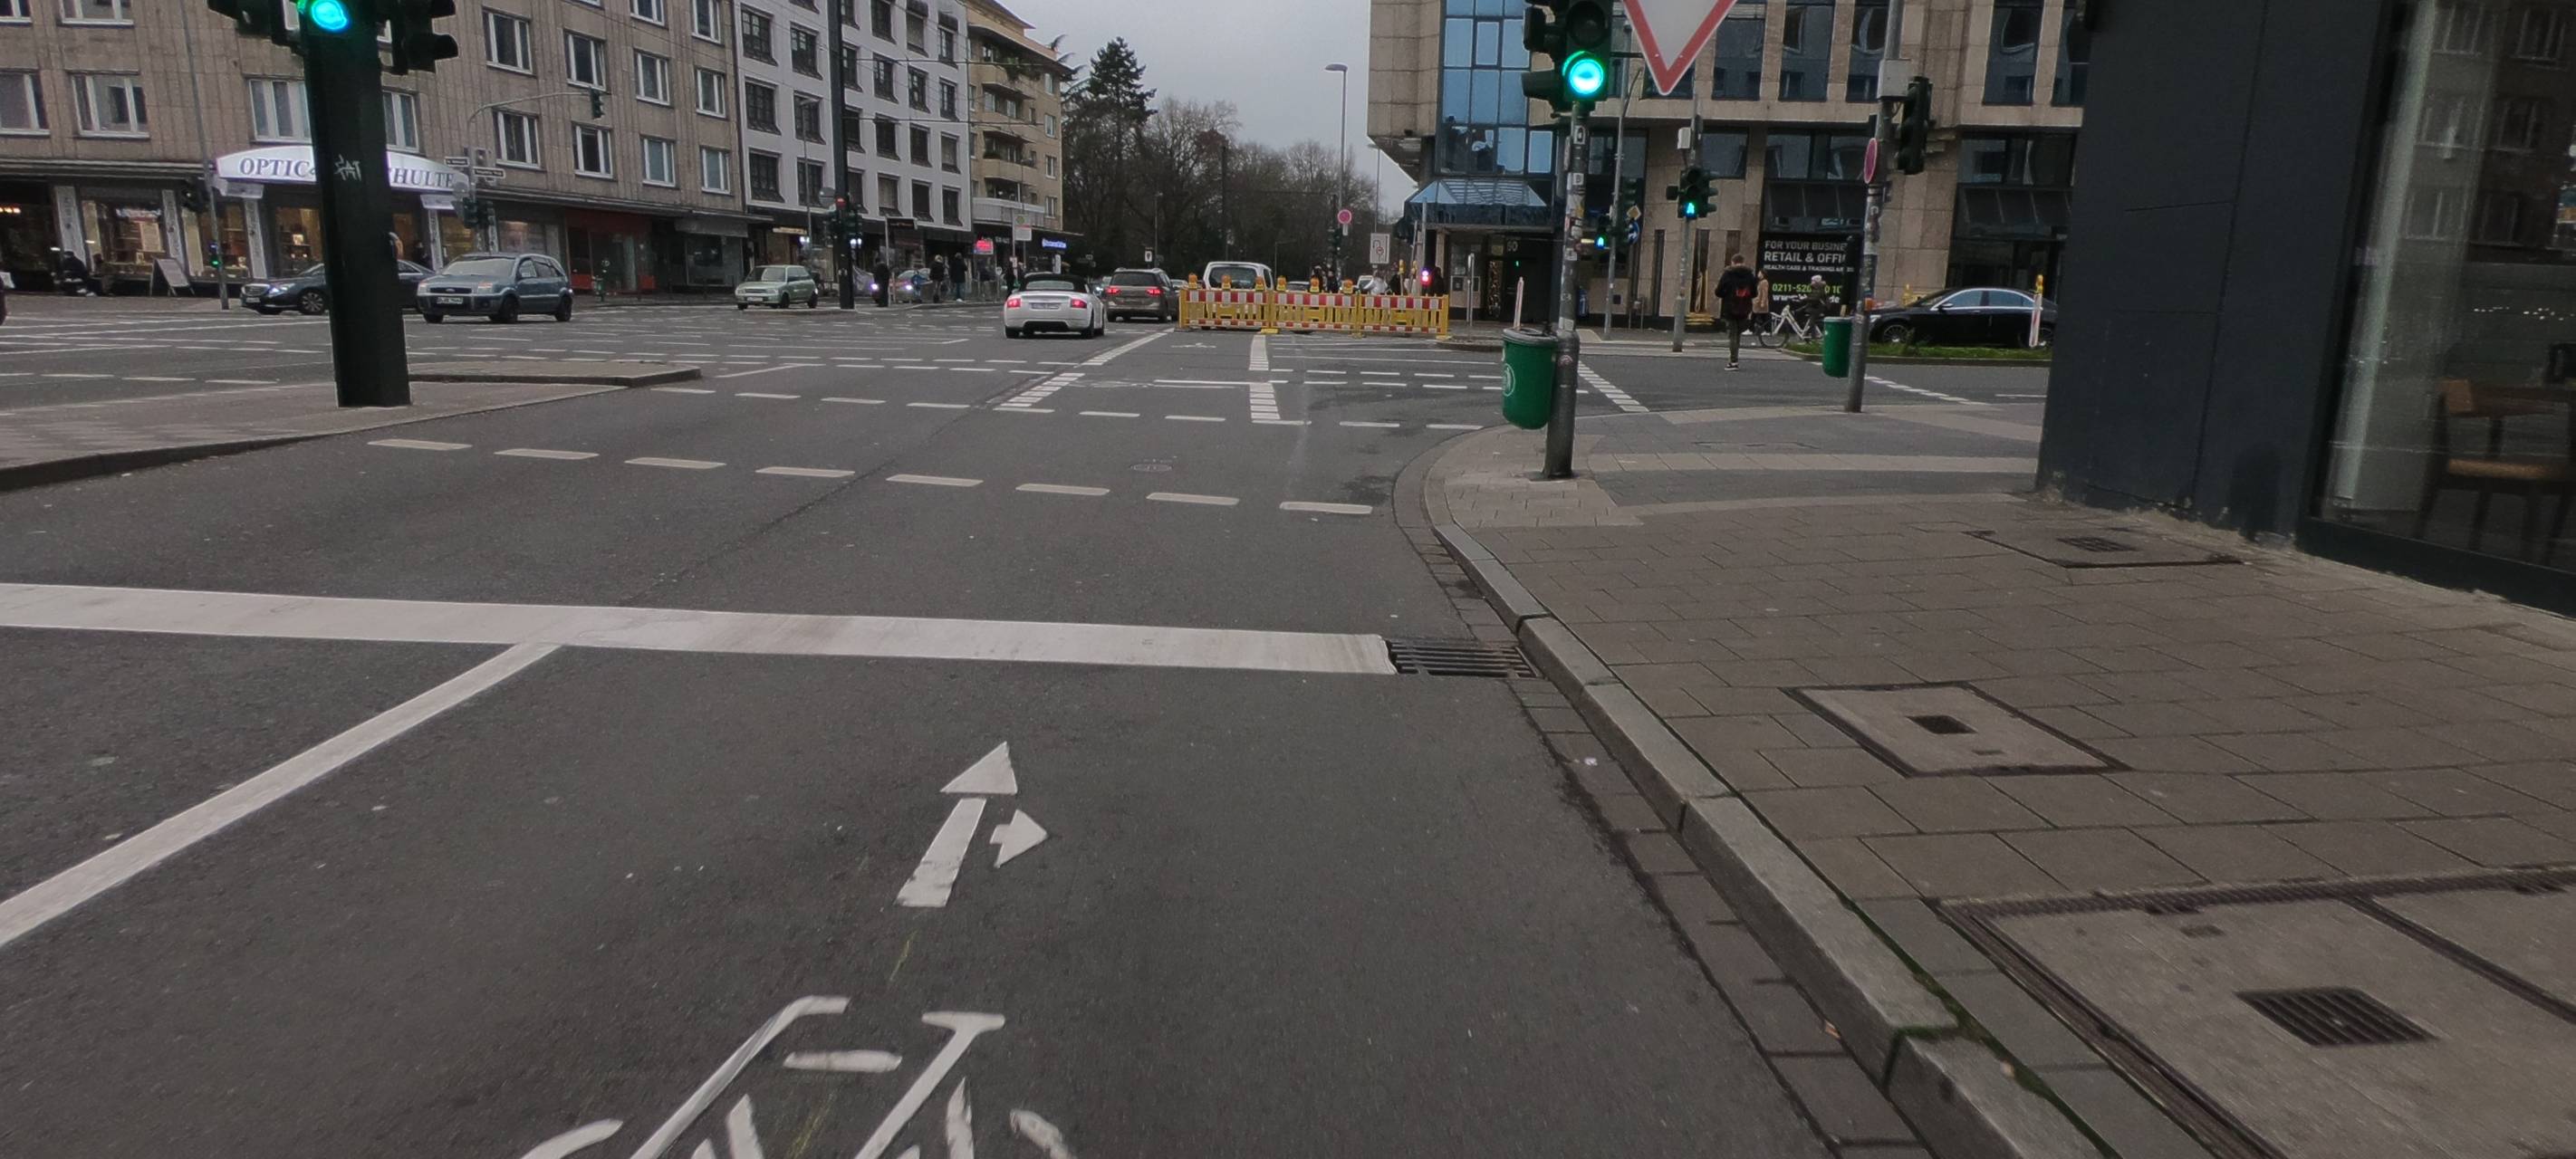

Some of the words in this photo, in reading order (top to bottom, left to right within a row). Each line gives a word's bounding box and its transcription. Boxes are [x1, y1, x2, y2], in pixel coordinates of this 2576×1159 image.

[390, 168, 455, 188] HULTE
[1764, 240, 1783, 250] FOR
[1785, 241, 1810, 251] YOUR
[1812, 242, 1848, 252] BUSINE
[1764, 251, 1802, 263] RETAIL
[1804, 253, 1814, 263] &
[1817, 253, 1847, 263] OFFI
